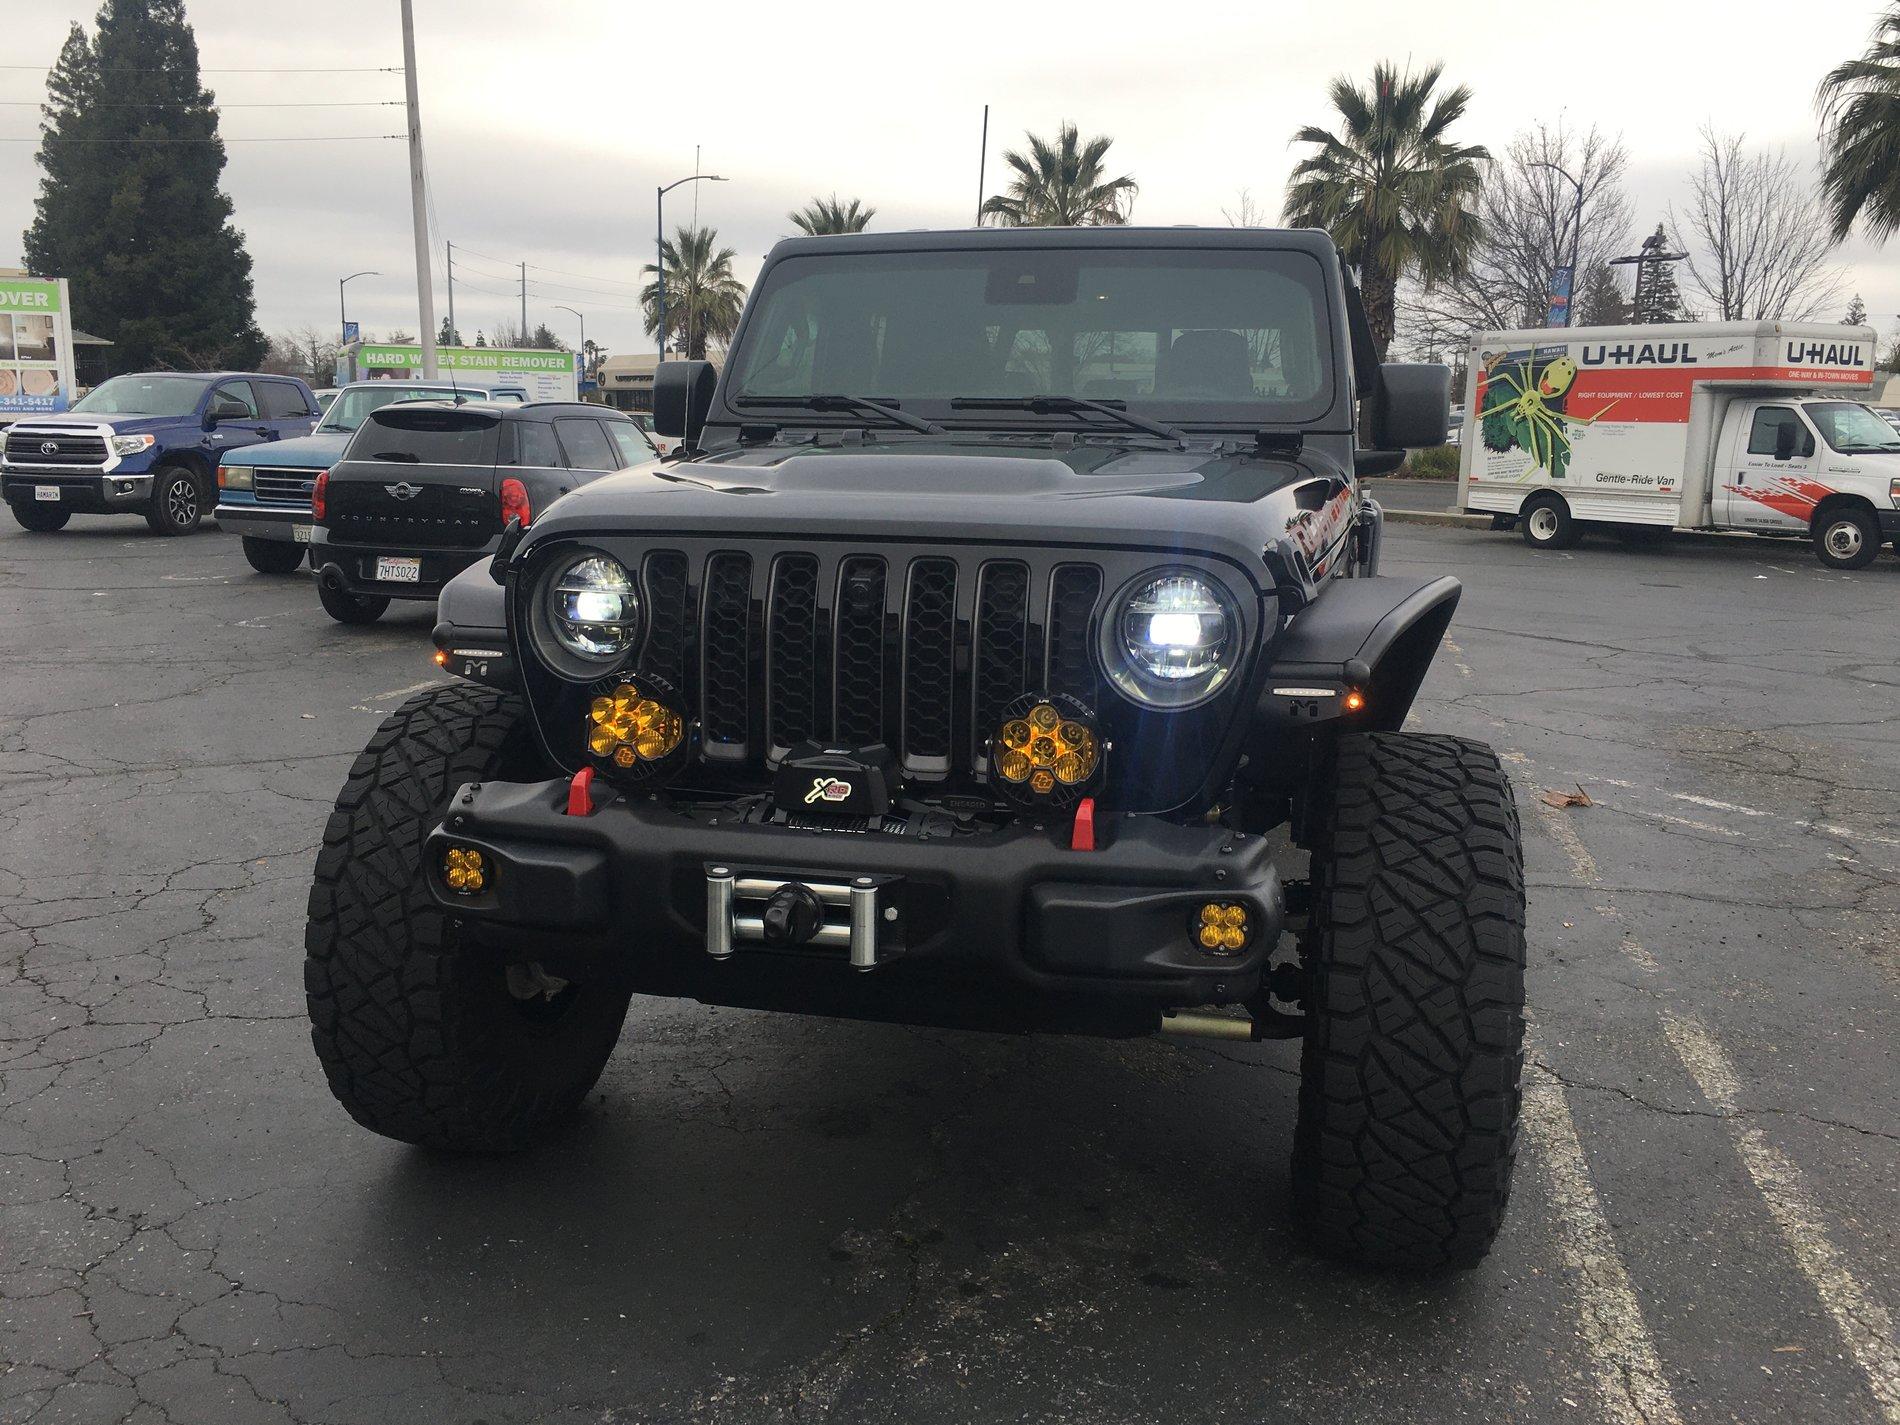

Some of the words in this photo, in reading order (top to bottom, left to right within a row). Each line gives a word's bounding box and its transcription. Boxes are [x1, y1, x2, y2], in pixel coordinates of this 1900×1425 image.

[366, 352, 405, 365] HARD
[409, 353, 456, 366] WER
[460, 354, 498, 367] STAIN
[502, 357, 566, 369] REMOVER
[1582, 343, 1698, 365] U-HAUL
[1787, 341, 1864, 366] U-HAUL
[1595, 473, 1654, 485] Gentle-Ride
[1656, 476, 1675, 486] Van
[341, 514, 479, 525] COUNTRYMAN
[379, 565, 418, 579] 7HTS022
